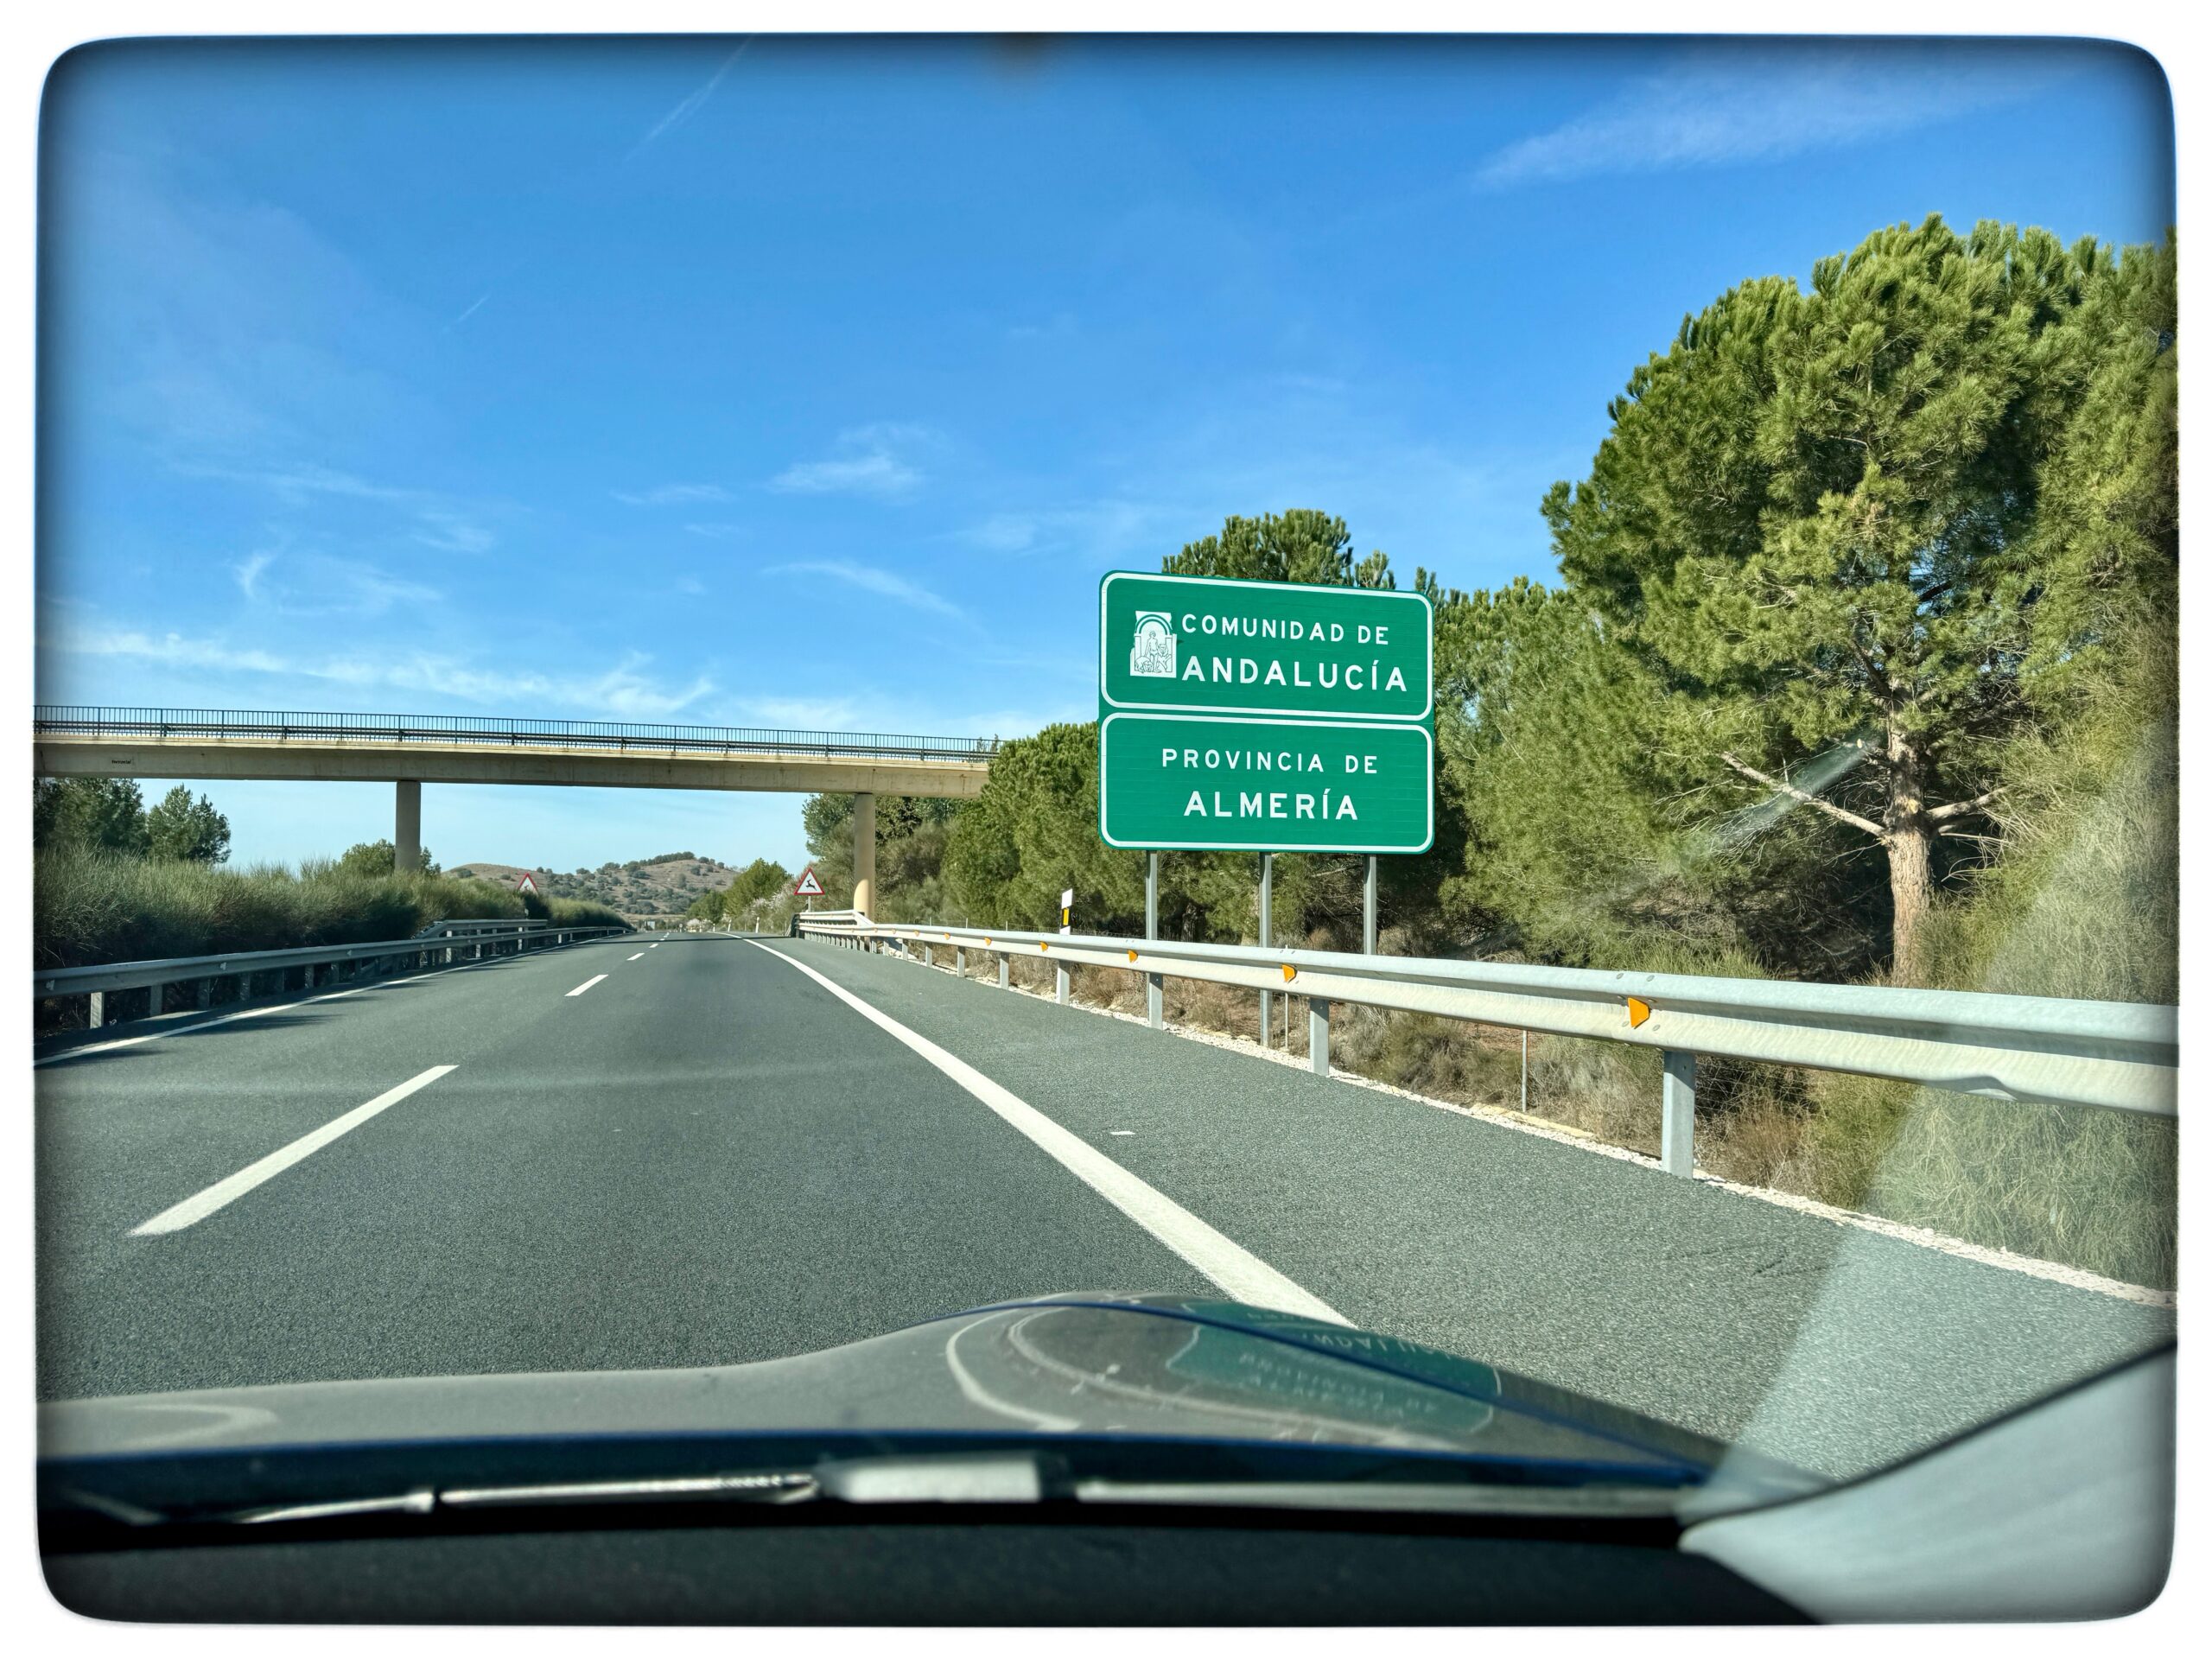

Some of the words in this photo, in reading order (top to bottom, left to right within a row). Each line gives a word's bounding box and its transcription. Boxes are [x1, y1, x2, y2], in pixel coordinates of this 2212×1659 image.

[1181, 613, 1344, 642] COMUNIDAD
[1357, 625, 1389, 645] DE
[1181, 655, 1407, 692] ANDALUCÍA
[1162, 748, 1324, 772] PROVINCIA
[1345, 754, 1377, 774] DE
[1183, 788, 1358, 820] ALMERÍA
